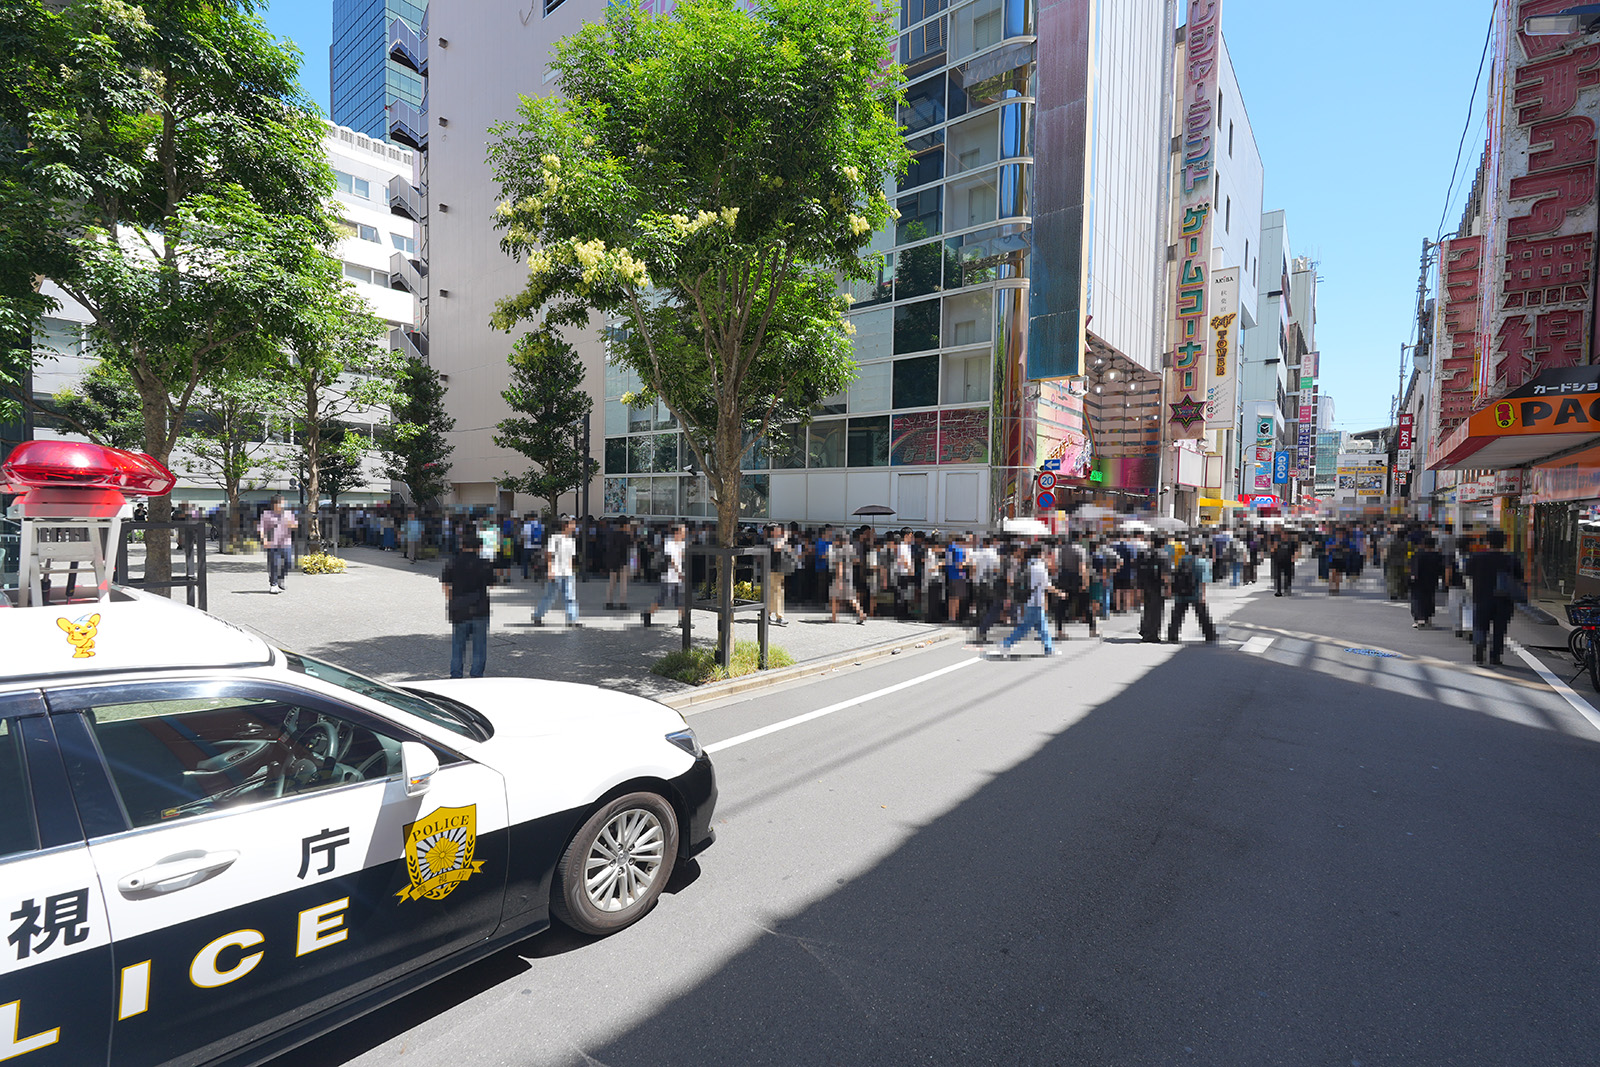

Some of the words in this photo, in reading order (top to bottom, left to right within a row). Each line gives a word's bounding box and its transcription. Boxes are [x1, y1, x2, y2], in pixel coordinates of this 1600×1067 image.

[1184, 0, 1216, 192] レジャーランド
[1177, 202, 1210, 388] ゲームコーナー
[1216, 330, 1228, 376] TOWER
[1533, 382, 1598, 394] カードショ
[1400, 430, 1409, 447] KFC
[1277, 455, 1287, 479] GiGO
[1041, 476, 1053, 486] 20
[412, 815, 470, 842] POLICE
